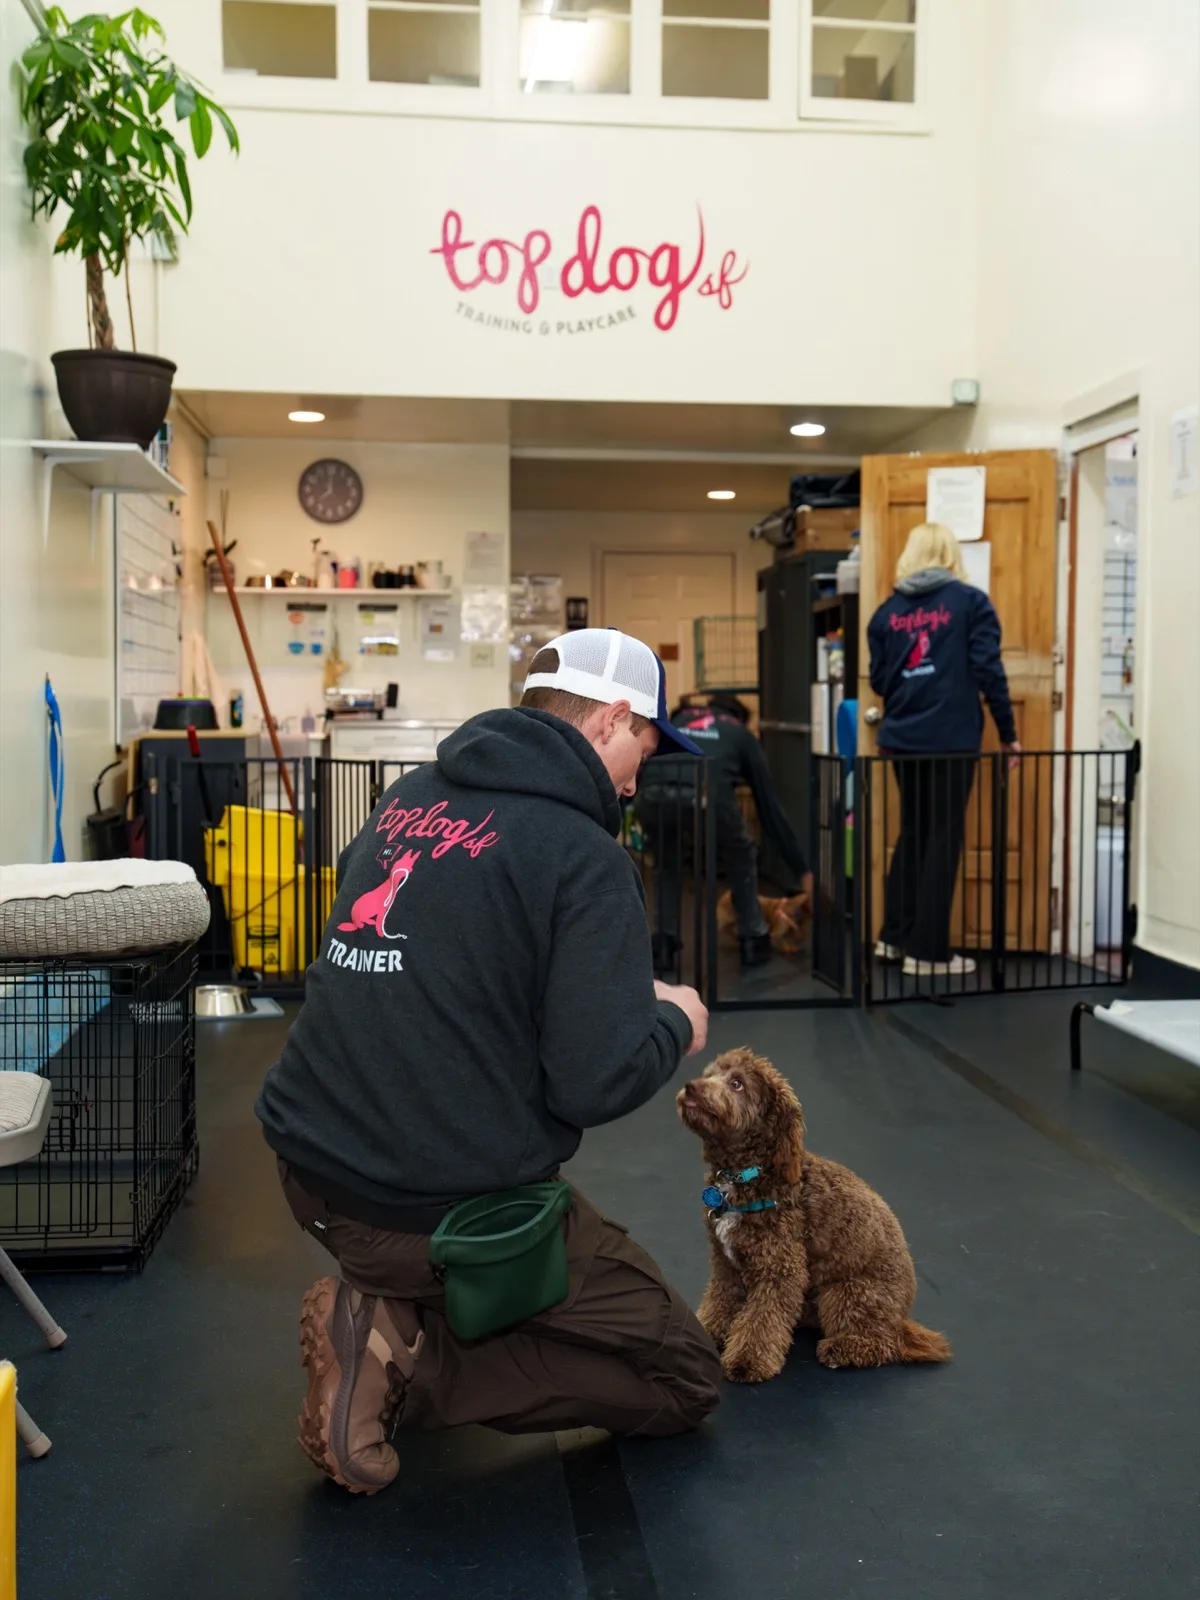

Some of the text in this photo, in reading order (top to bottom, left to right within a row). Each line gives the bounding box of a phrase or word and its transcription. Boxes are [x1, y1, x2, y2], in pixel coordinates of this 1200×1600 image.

[455, 301, 532, 334] TRAINING
[556, 304, 637, 335] PLAYCARE
[326, 937, 404, 973] TRAINER
